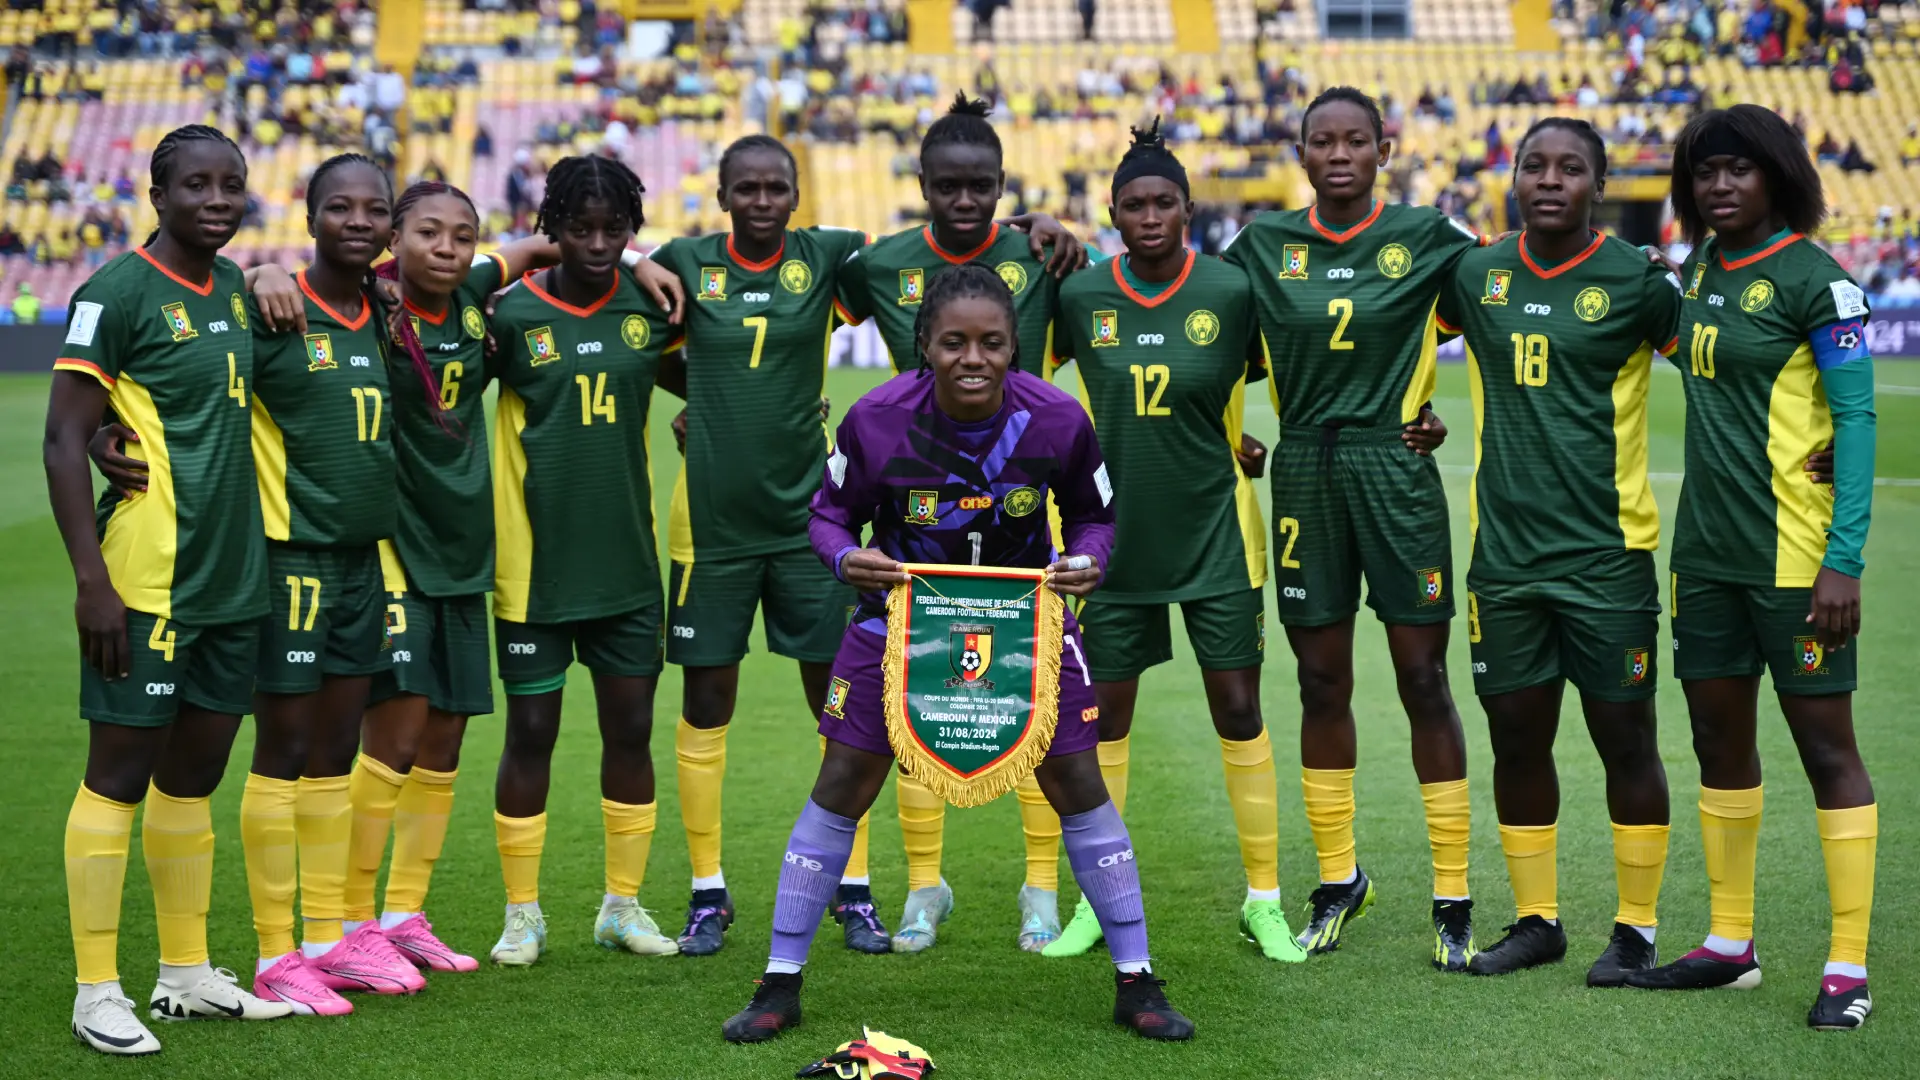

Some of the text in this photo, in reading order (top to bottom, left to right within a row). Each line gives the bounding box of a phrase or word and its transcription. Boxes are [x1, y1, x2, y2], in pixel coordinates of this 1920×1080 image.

[1326, 267, 1355, 280] one
[743, 291, 771, 303] one
[1708, 293, 1725, 307] one
[1524, 302, 1552, 316] one
[208, 319, 229, 334] one
[1328, 299, 1354, 350] 2
[743, 316, 767, 368] 7
[1136, 332, 1165, 346] one
[577, 340, 603, 355] one
[1691, 323, 1718, 380] 10
[349, 355, 370, 368] one
[1511, 333, 1549, 387] 18
[227, 352, 246, 408] 4
[439, 361, 464, 411] 6
[1130, 364, 1171, 416] 12
[575, 372, 616, 426] 14
[351, 387, 381, 442] 17
[960, 496, 993, 510] one
[967, 532, 982, 566] 1
[1280, 517, 1300, 569] 2
[1283, 586, 1306, 600] one
[286, 575, 321, 631] 17
[916, 595, 1030, 609] FEDERATION CAMEROUNAISE DE FOOTBALL
[925, 606, 1020, 619] CAMEROON FOOTBALL FEDERATION
[148, 616, 176, 662] 4
[673, 625, 695, 638] one
[508, 643, 536, 655] one
[287, 650, 316, 664] one
[1063, 635, 1091, 687] 1
[1471, 661, 1487, 674] ne
[146, 682, 175, 696] one
[920, 712, 968, 723] CAMEROUN
[979, 714, 1017, 725] MEXIQUE
[1081, 706, 1099, 723] one
[939, 726, 997, 739] 31/08/2024
[784, 850, 824, 872] one
[1097, 848, 1135, 868] one
